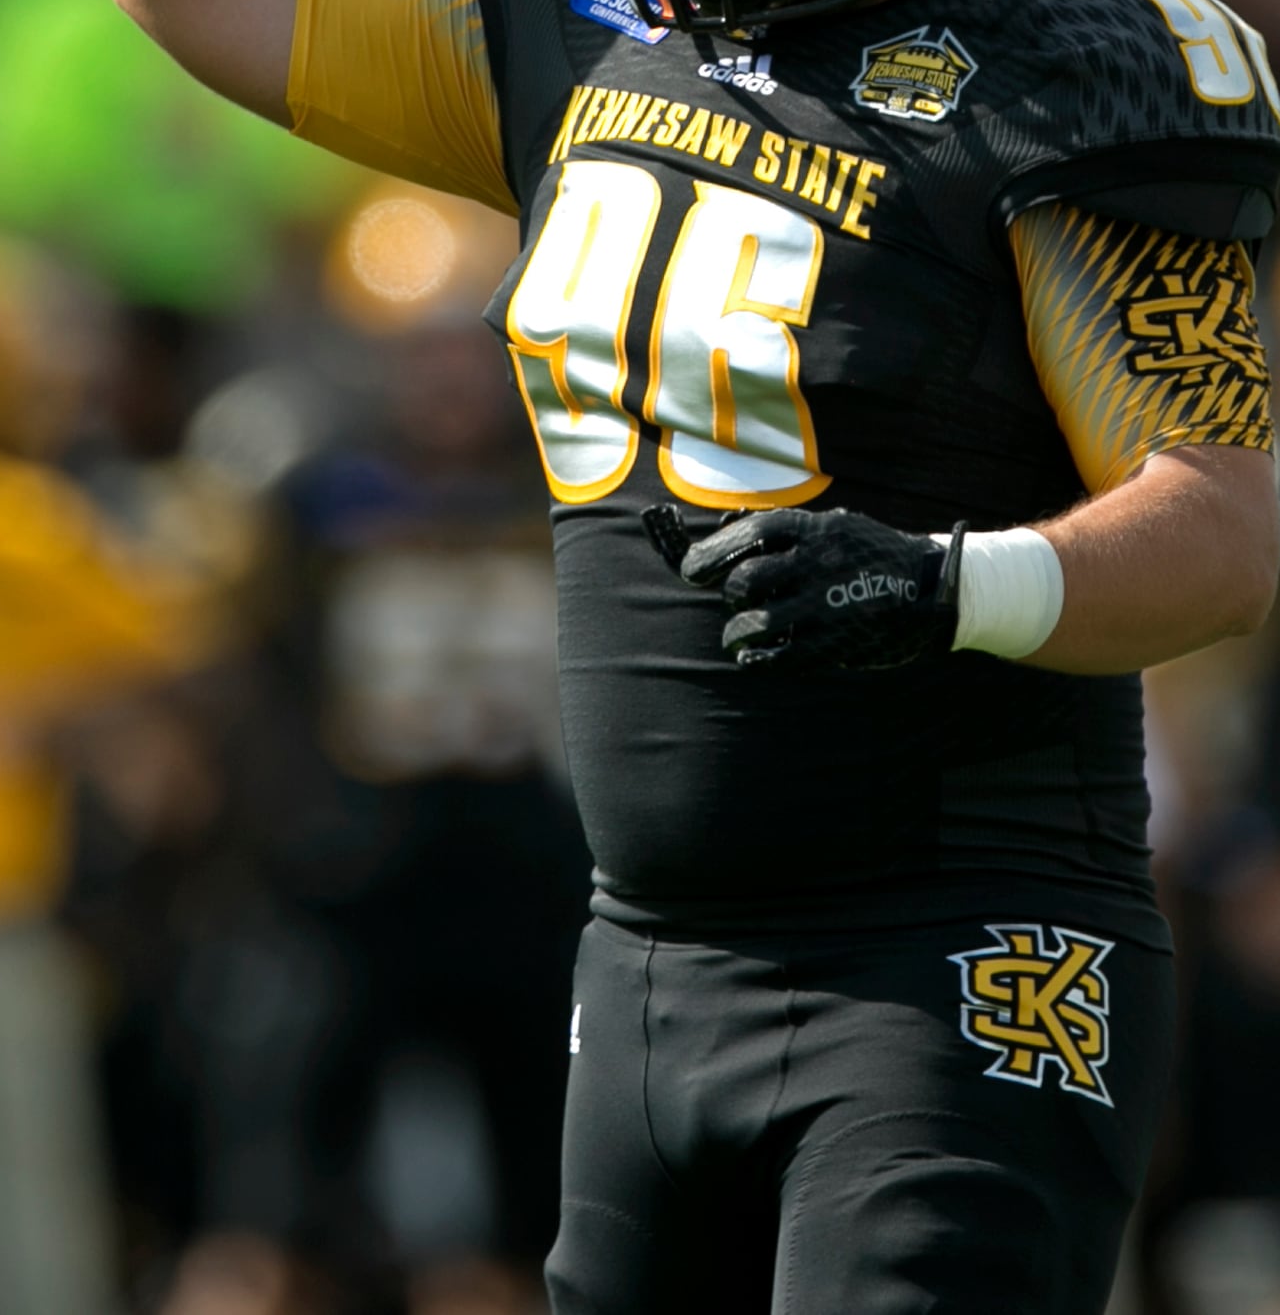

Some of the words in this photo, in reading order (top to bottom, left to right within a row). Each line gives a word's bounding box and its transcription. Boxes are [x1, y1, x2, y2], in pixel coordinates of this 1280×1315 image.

[698, 58, 779, 96] adidas
[863, 61, 929, 82] KENNESAW
[924, 69, 958, 97] STATE
[548, 84, 752, 167] KENNESAW
[753, 130, 886, 240] STATE
[506, 159, 833, 512] 96
[826, 571, 919, 608] adizero
